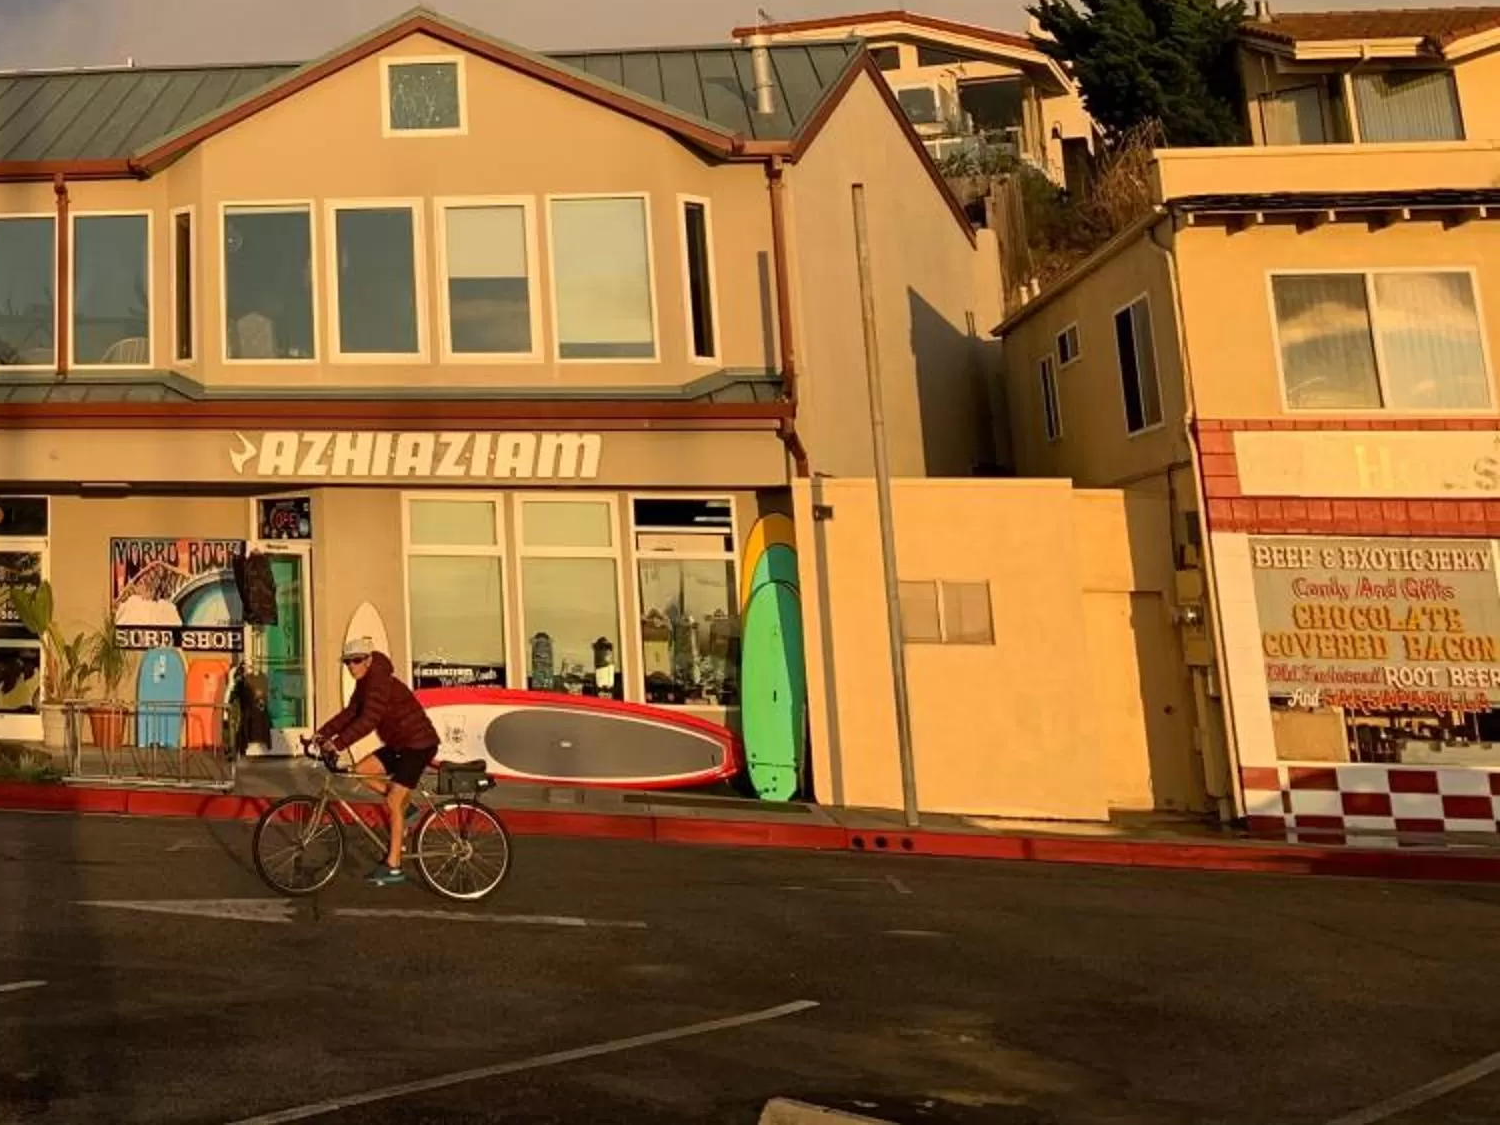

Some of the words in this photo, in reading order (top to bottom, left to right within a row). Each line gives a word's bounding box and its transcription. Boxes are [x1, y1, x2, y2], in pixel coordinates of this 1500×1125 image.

[257, 431, 602, 479] AZHIAZIAM
[1340, 546, 1425, 571] EXOTIC
[1426, 548, 1492, 573] JERKY
[1291, 576, 1349, 601] Candy
[1355, 577, 1398, 598] And
[1402, 577, 1455, 601] Gifts
[1292, 603, 1464, 633] CHOCOLATE
[116, 629, 173, 648] SURF
[181, 631, 242, 650] SHOP
[1262, 632, 1390, 660] COVERED
[1403, 634, 1498, 662] BACON
[1384, 666, 1441, 688] ROOT
[1287, 688, 1320, 707] And
